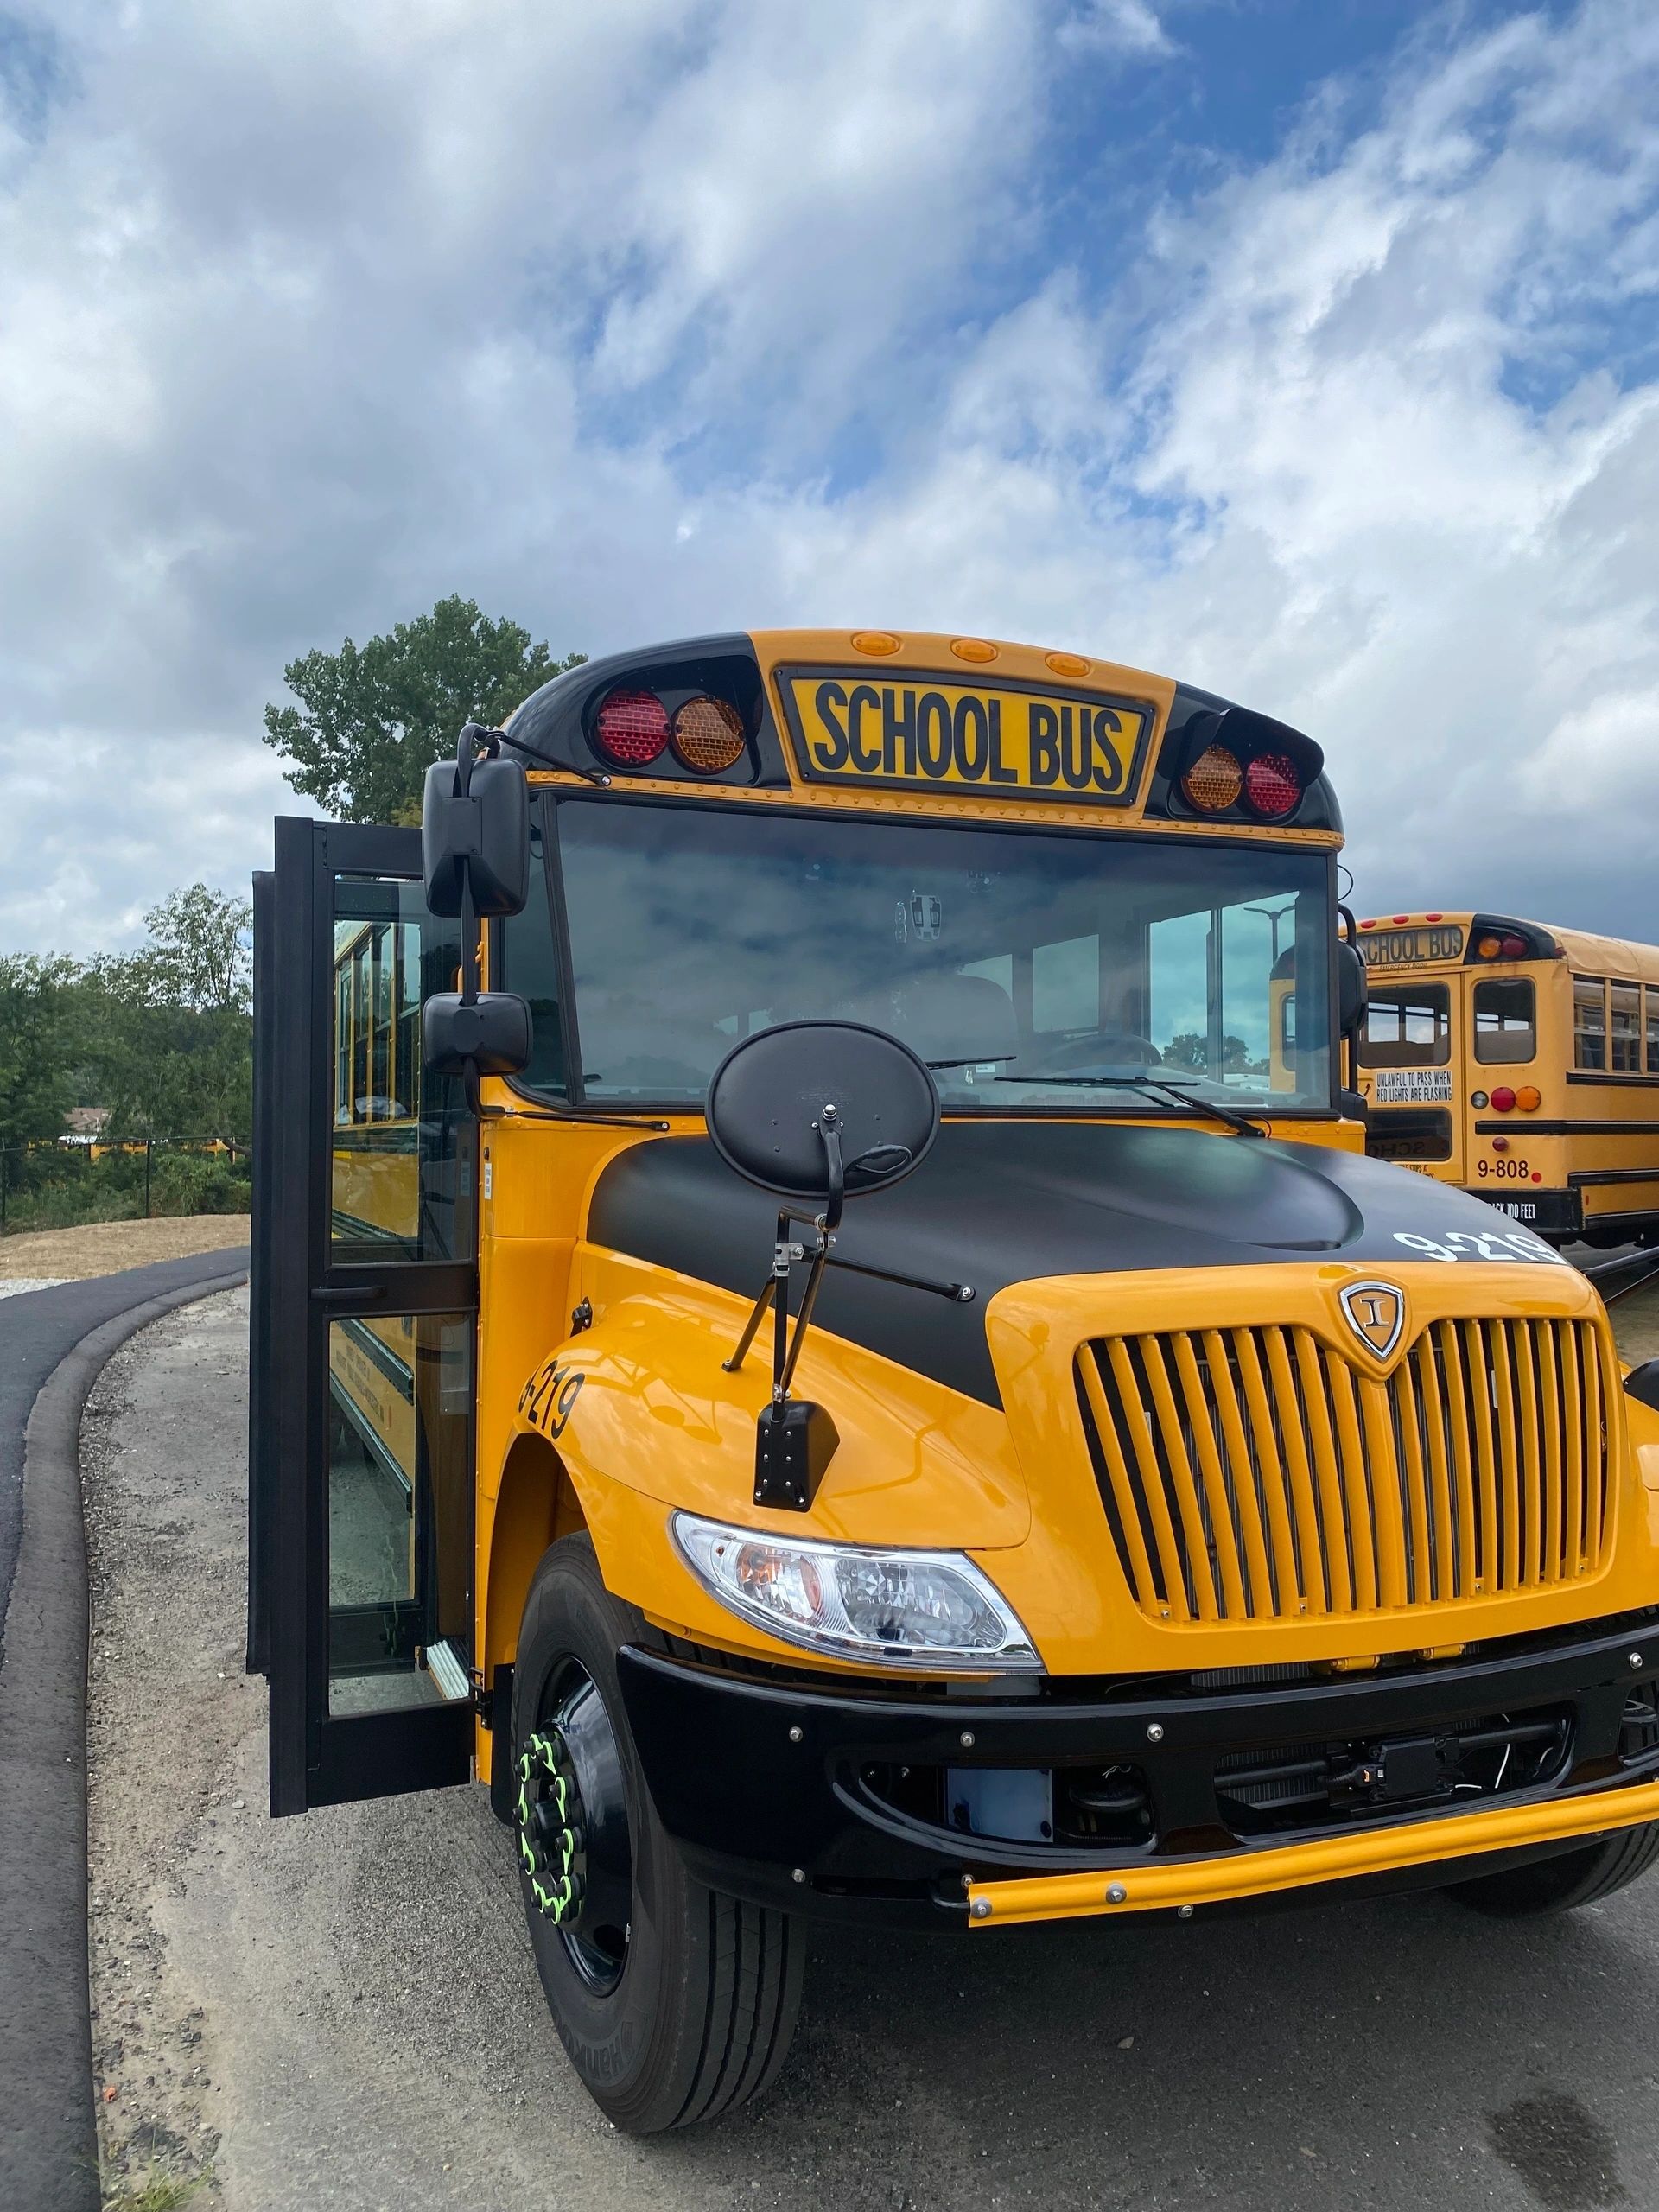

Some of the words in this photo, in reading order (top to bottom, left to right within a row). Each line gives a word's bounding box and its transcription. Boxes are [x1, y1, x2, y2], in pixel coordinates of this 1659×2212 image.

[814, 682, 1018, 783] SCHOOL
[1029, 703, 1122, 792] BUS
[1376, 1073, 1406, 1087] UNLAWFUL
[1408, 1072, 1415, 1086] TO
[1417, 1071, 1432, 1086] PASS
[1434, 1071, 1451, 1085] WHEN
[1376, 1089, 1387, 1102] RED
[1389, 1088, 1408, 1102] LIGHTS
[1411, 1088, 1421, 1101] ARE
[1424, 1087, 1452, 1101] FLASHING
[1478, 1160, 1529, 1179] 9-808
[1507, 1203, 1519, 1219] 100
[1521, 1203, 1536, 1219] FEET
[1392, 1232, 1568, 1265] 9-219
